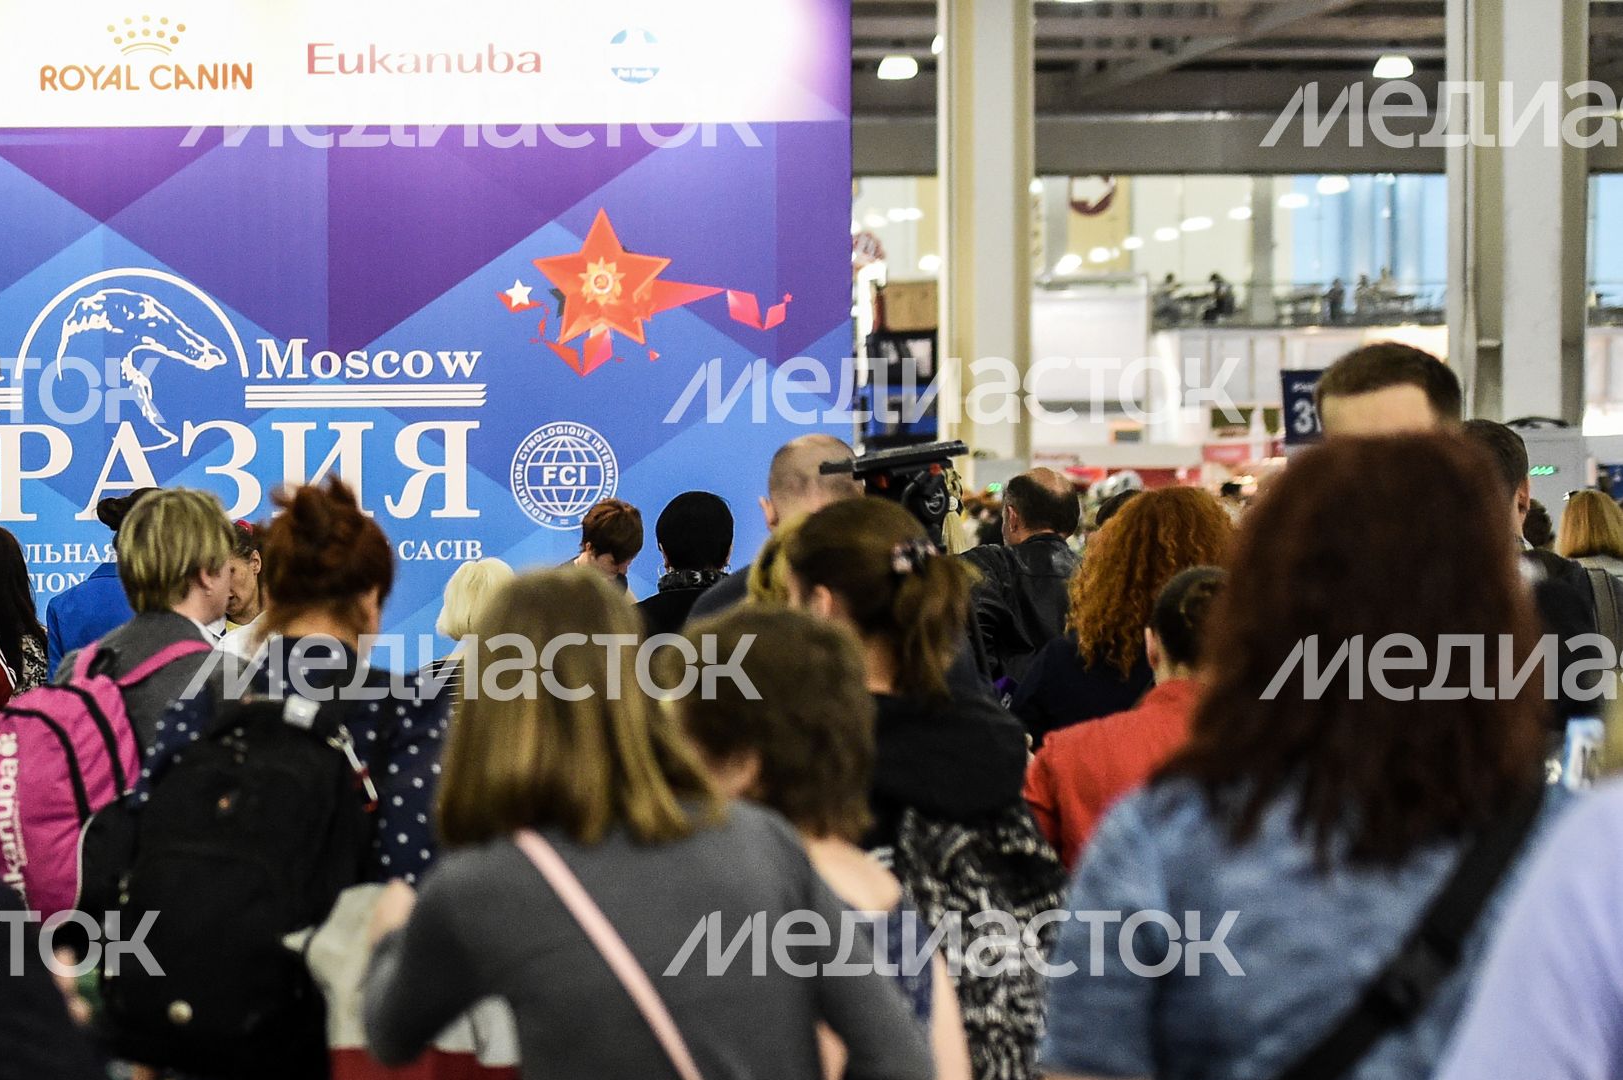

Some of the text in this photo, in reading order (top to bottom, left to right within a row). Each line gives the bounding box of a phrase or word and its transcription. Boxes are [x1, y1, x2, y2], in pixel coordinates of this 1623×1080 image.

[307, 43, 542, 75] Eukanuba
[39, 62, 253, 91] ROYAL CANIN
[256, 338, 482, 379] Moscow
[543, 466, 587, 486] FCI
